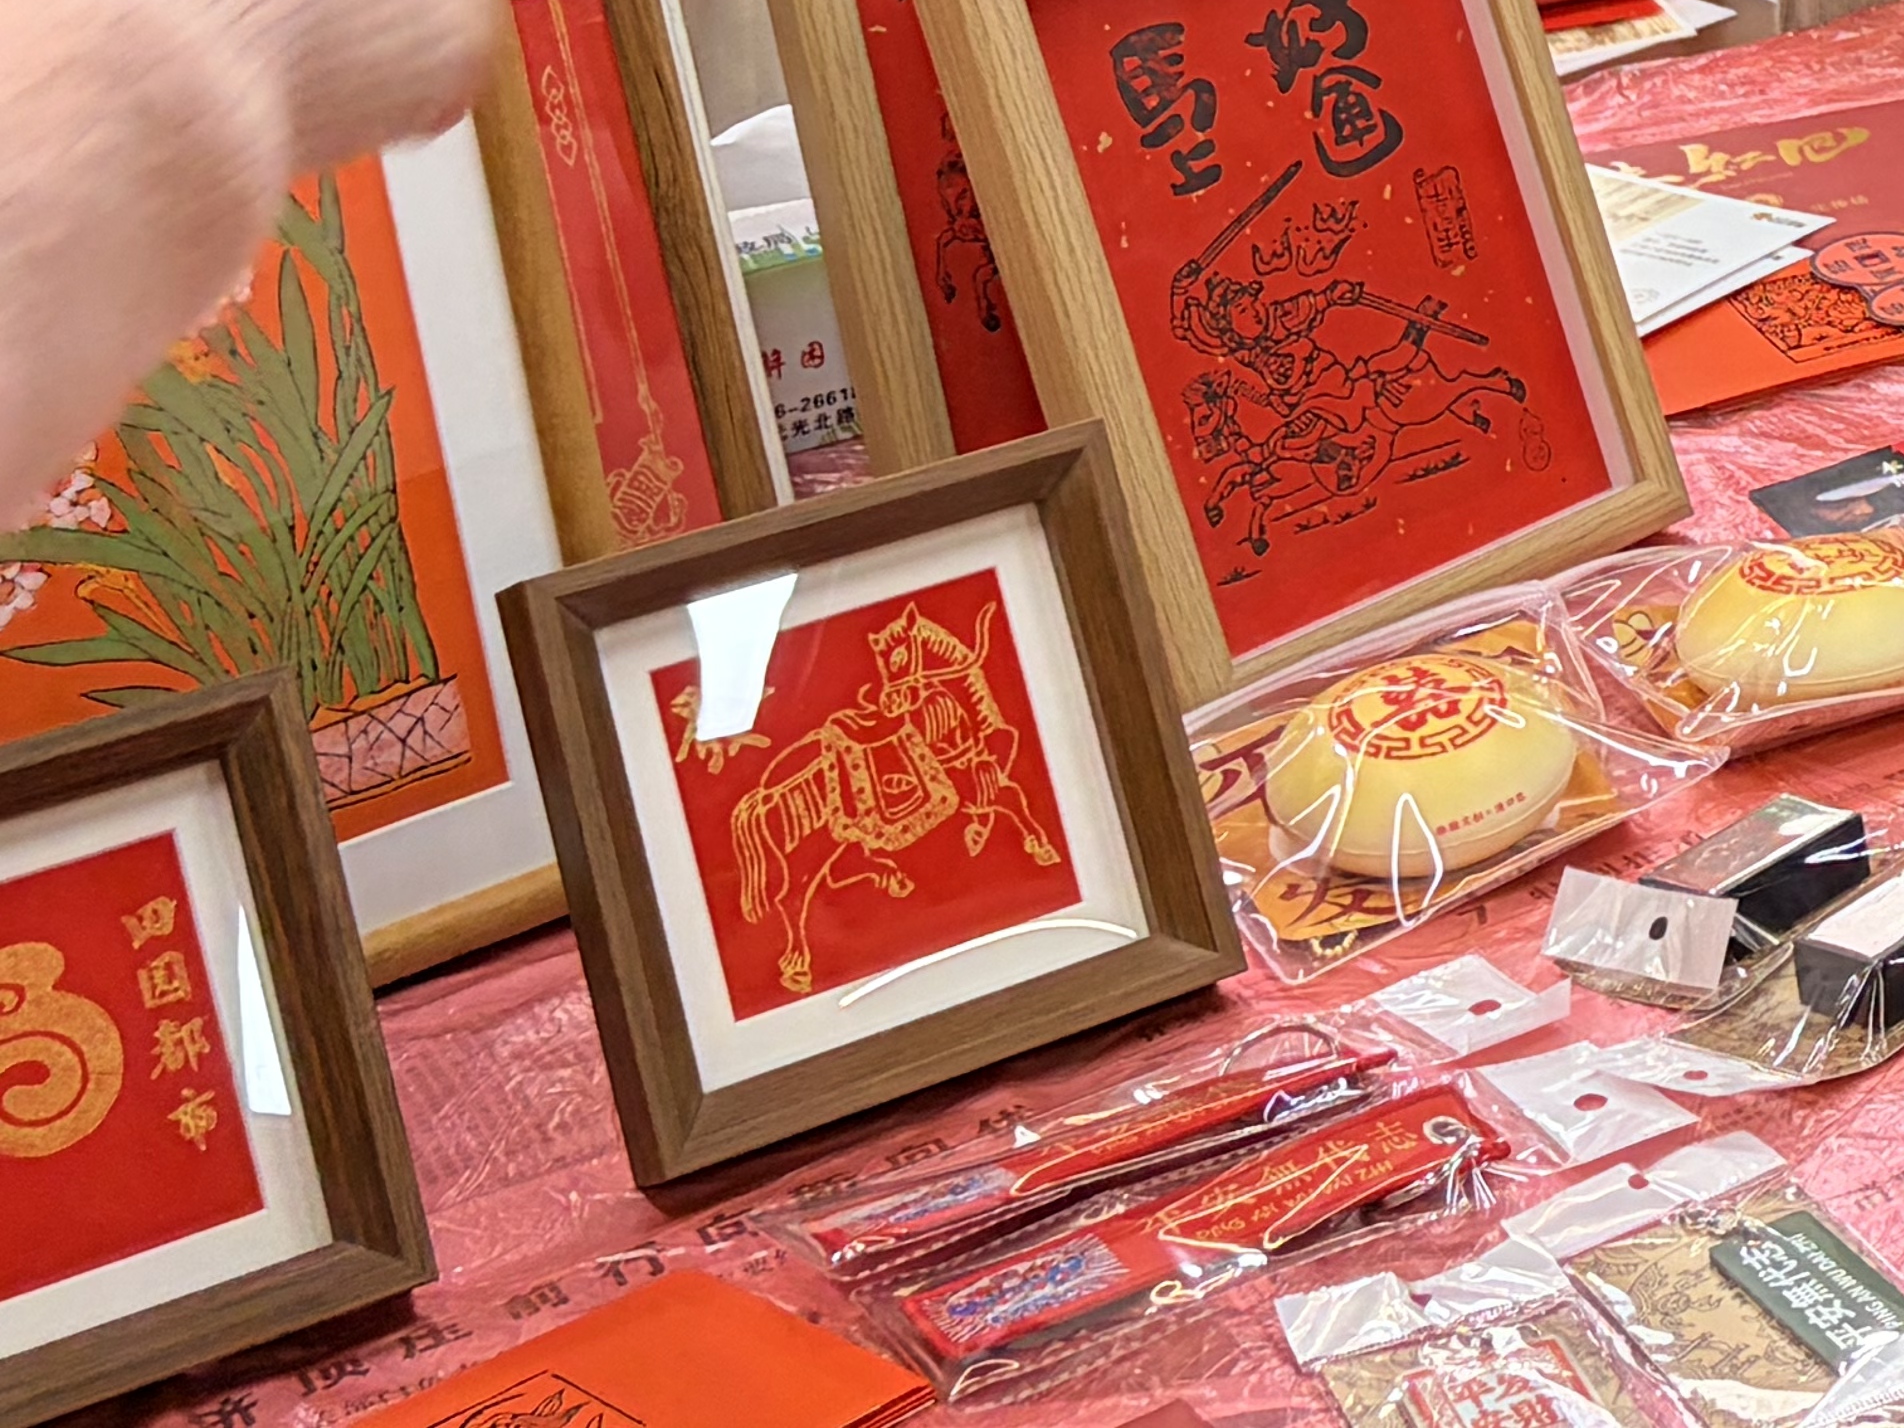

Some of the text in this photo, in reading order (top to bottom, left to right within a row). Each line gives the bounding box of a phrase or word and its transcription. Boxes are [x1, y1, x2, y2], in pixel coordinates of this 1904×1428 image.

[1827, 1266, 1858, 1290] WU
[1738, 1232, 1882, 1358] 平安無代志
[1847, 1283, 1877, 1306] AN
[1866, 1299, 1904, 1330] PING
